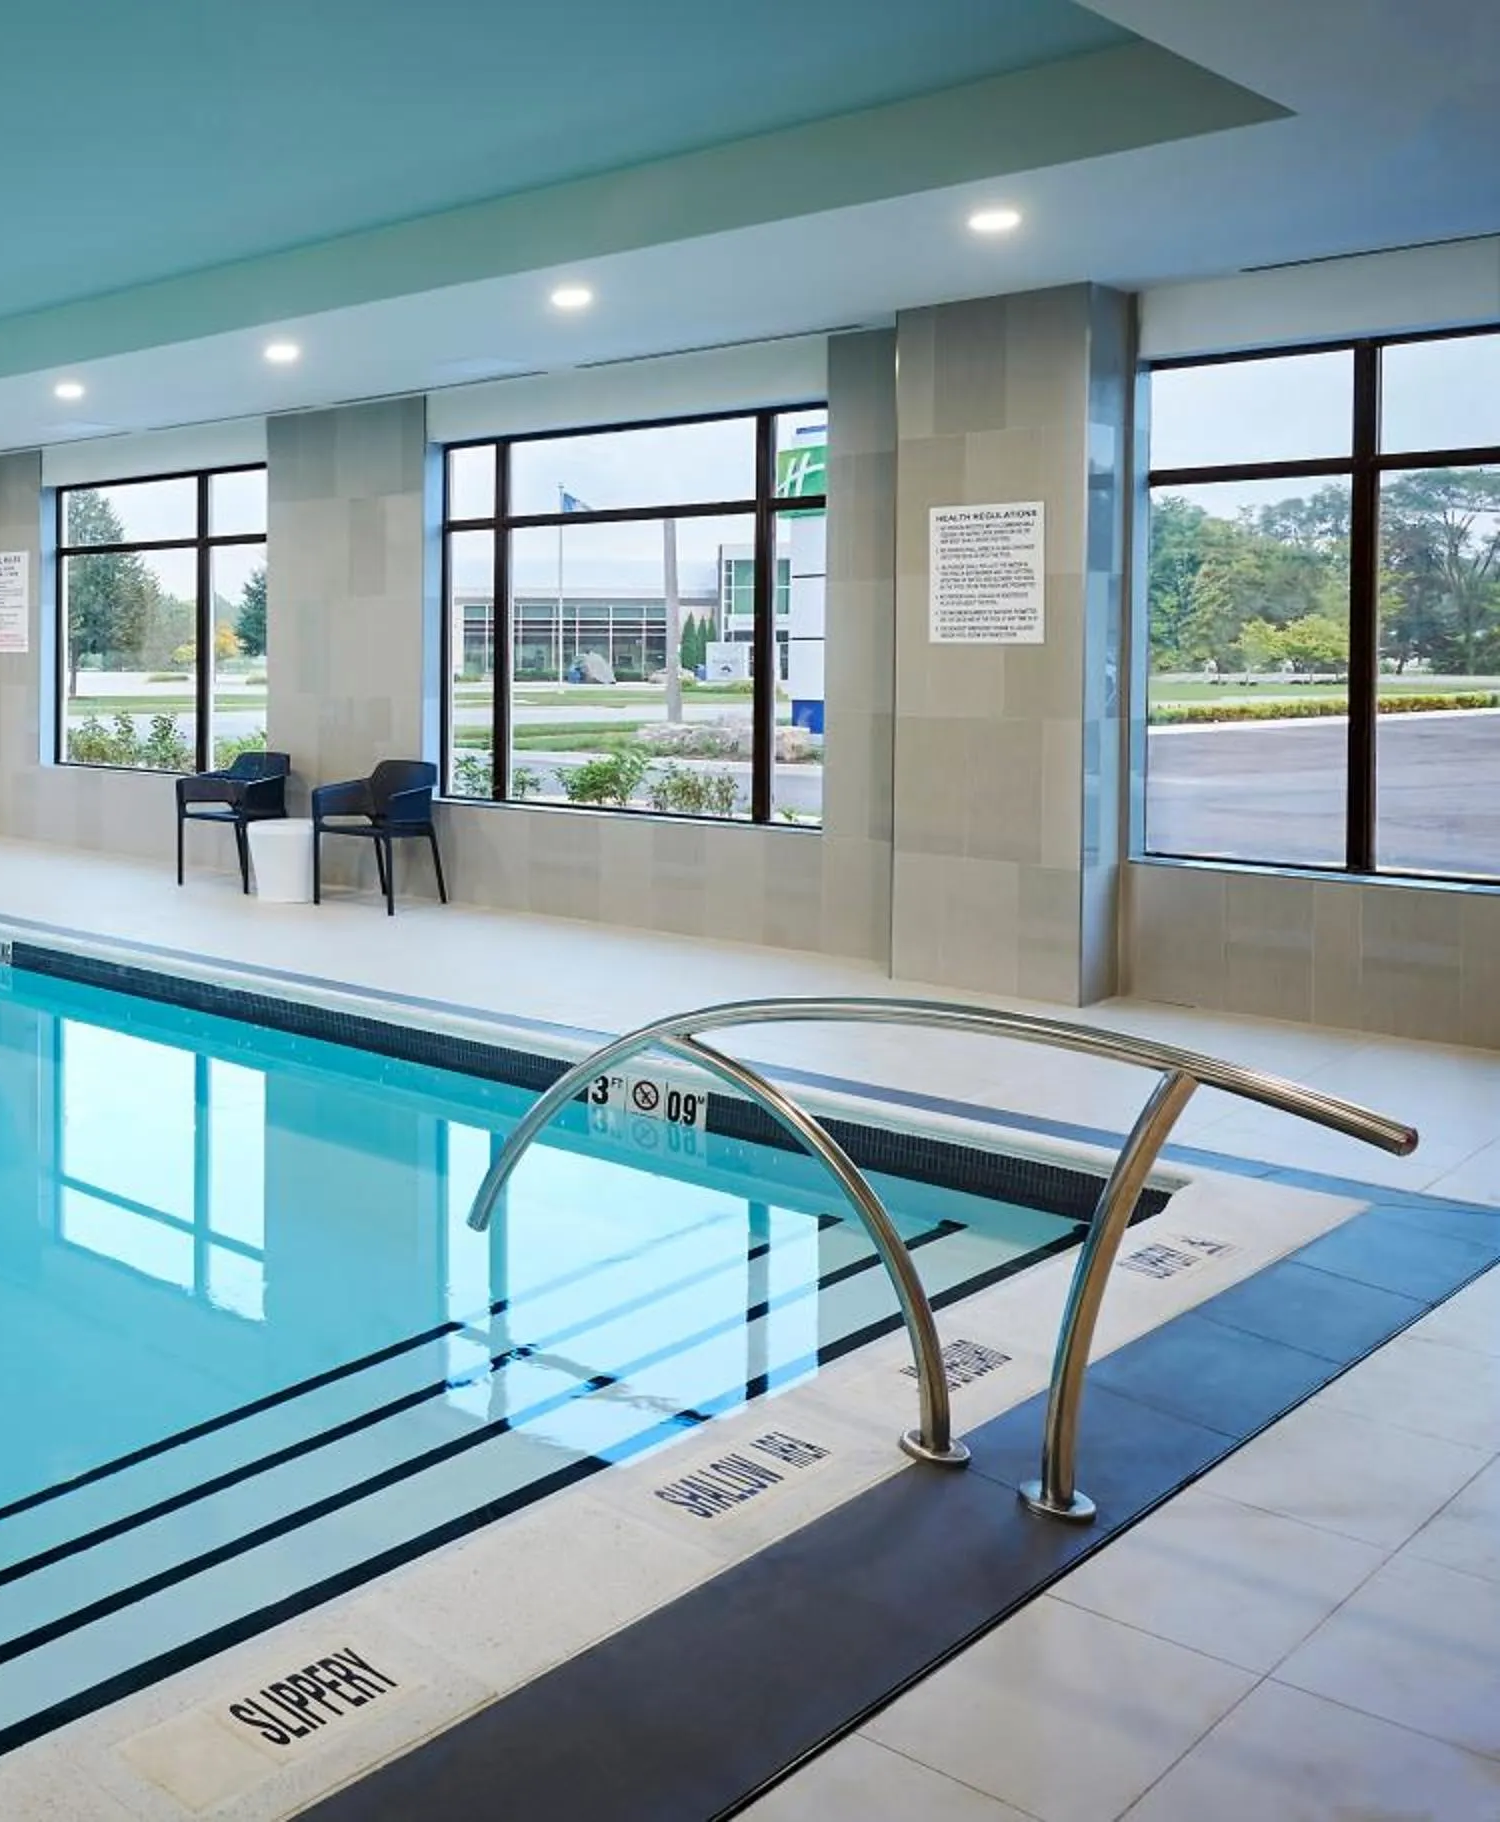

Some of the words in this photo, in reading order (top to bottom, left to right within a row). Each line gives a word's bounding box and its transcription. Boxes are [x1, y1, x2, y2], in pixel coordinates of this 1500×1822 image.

[936, 513, 970, 523] HEALTH
[973, 509, 1037, 520] REGULATIONS
[654, 1453, 785, 1518] SHALLOW
[229, 1647, 398, 1745] SLIPPERY
